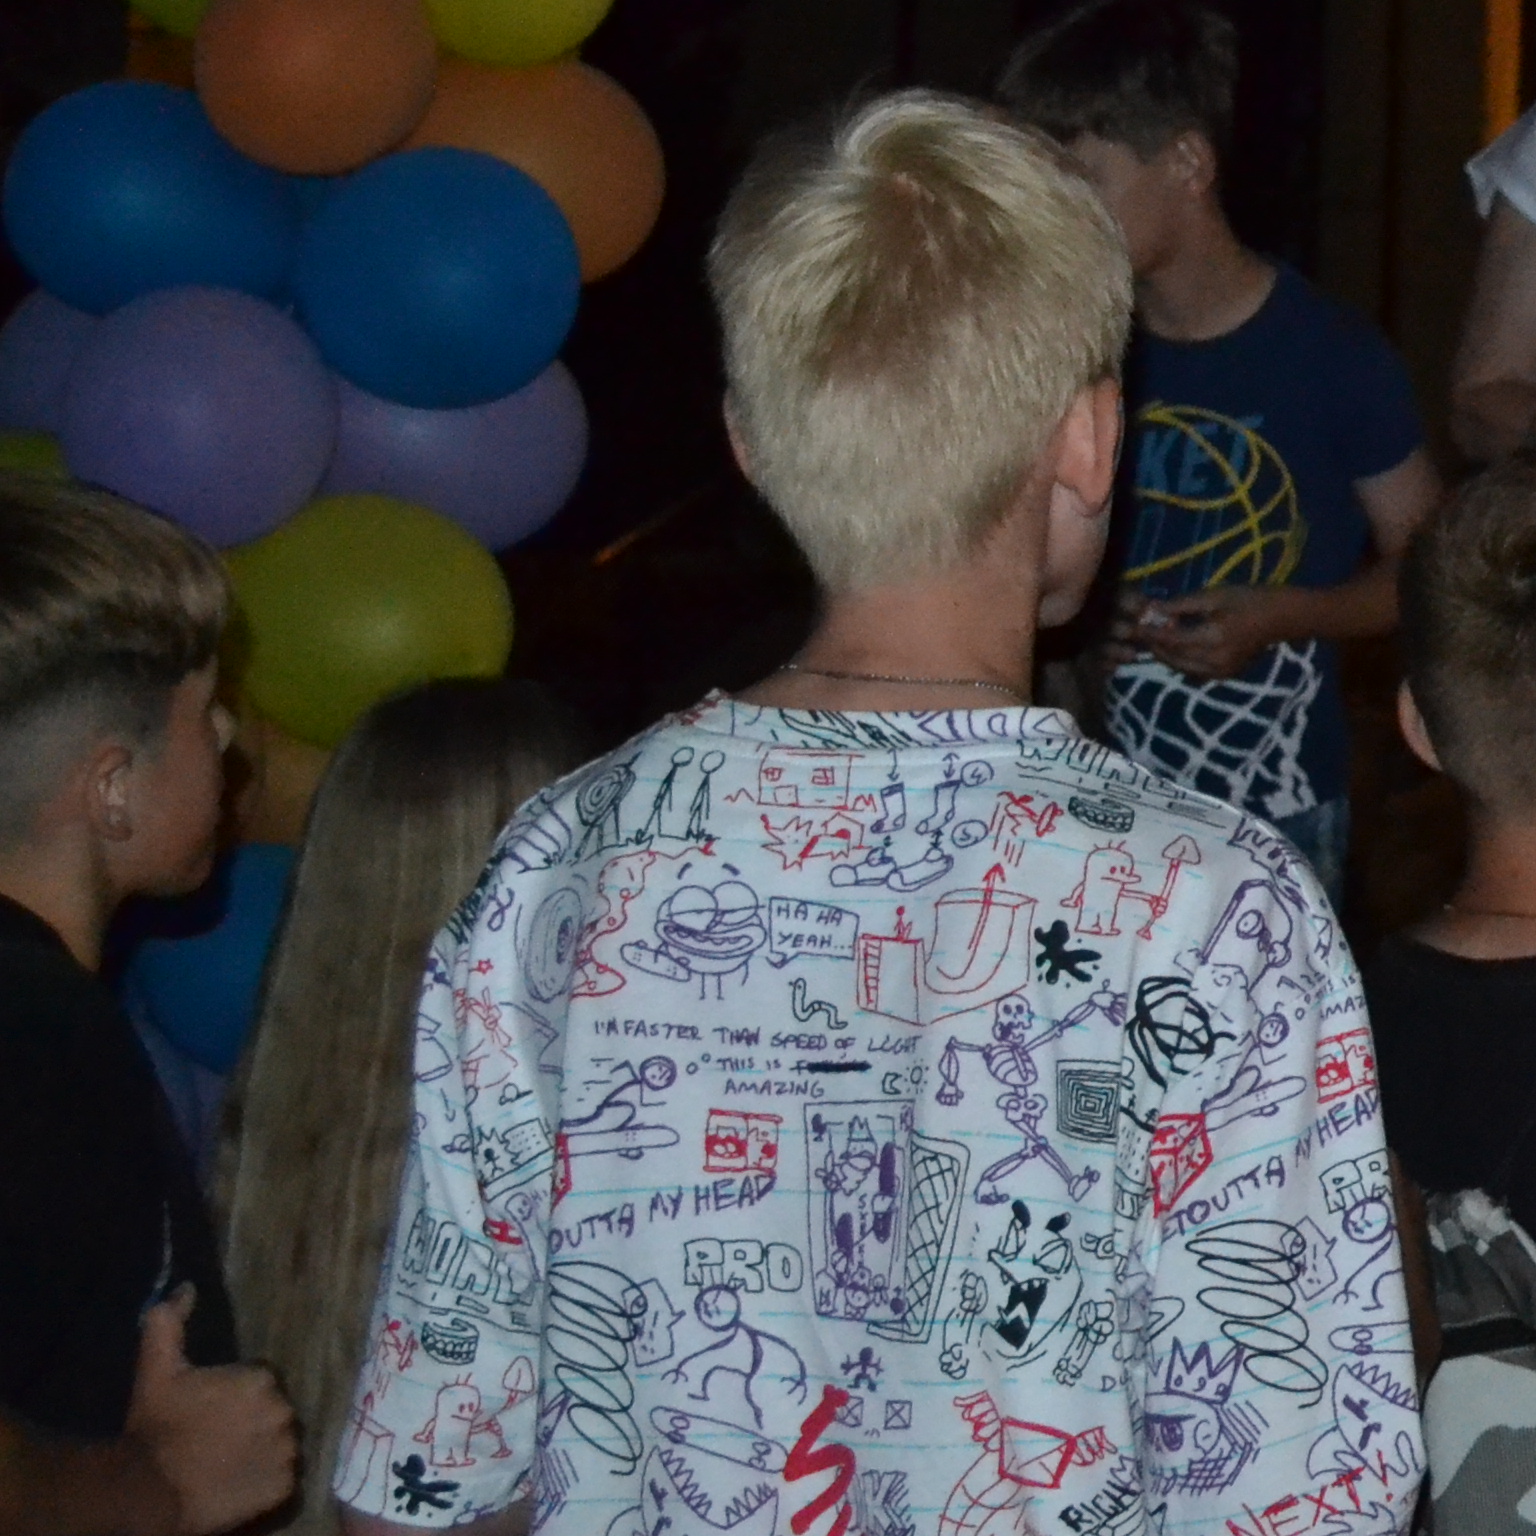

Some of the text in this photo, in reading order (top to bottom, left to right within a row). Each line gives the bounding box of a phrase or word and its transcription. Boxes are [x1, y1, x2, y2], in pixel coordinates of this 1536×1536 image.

[775, 901, 844, 929] HA HA
[622, 1020, 703, 1042] FASTER
[712, 1026, 762, 1048] THAN
[770, 1030, 828, 1052] SPEED
[833, 1035, 857, 1052] OF
[866, 1035, 925, 1056] LIGHT
[715, 1056, 755, 1072] THIS
[764, 1058, 782, 1073] IS
[724, 1075, 826, 1100] AMAZING
[1315, 1089, 1381, 1147] HEAD
[648, 1184, 685, 1224] MY
[693, 1174, 778, 1217] HEAD
[682, 1236, 805, 1294] PRO
